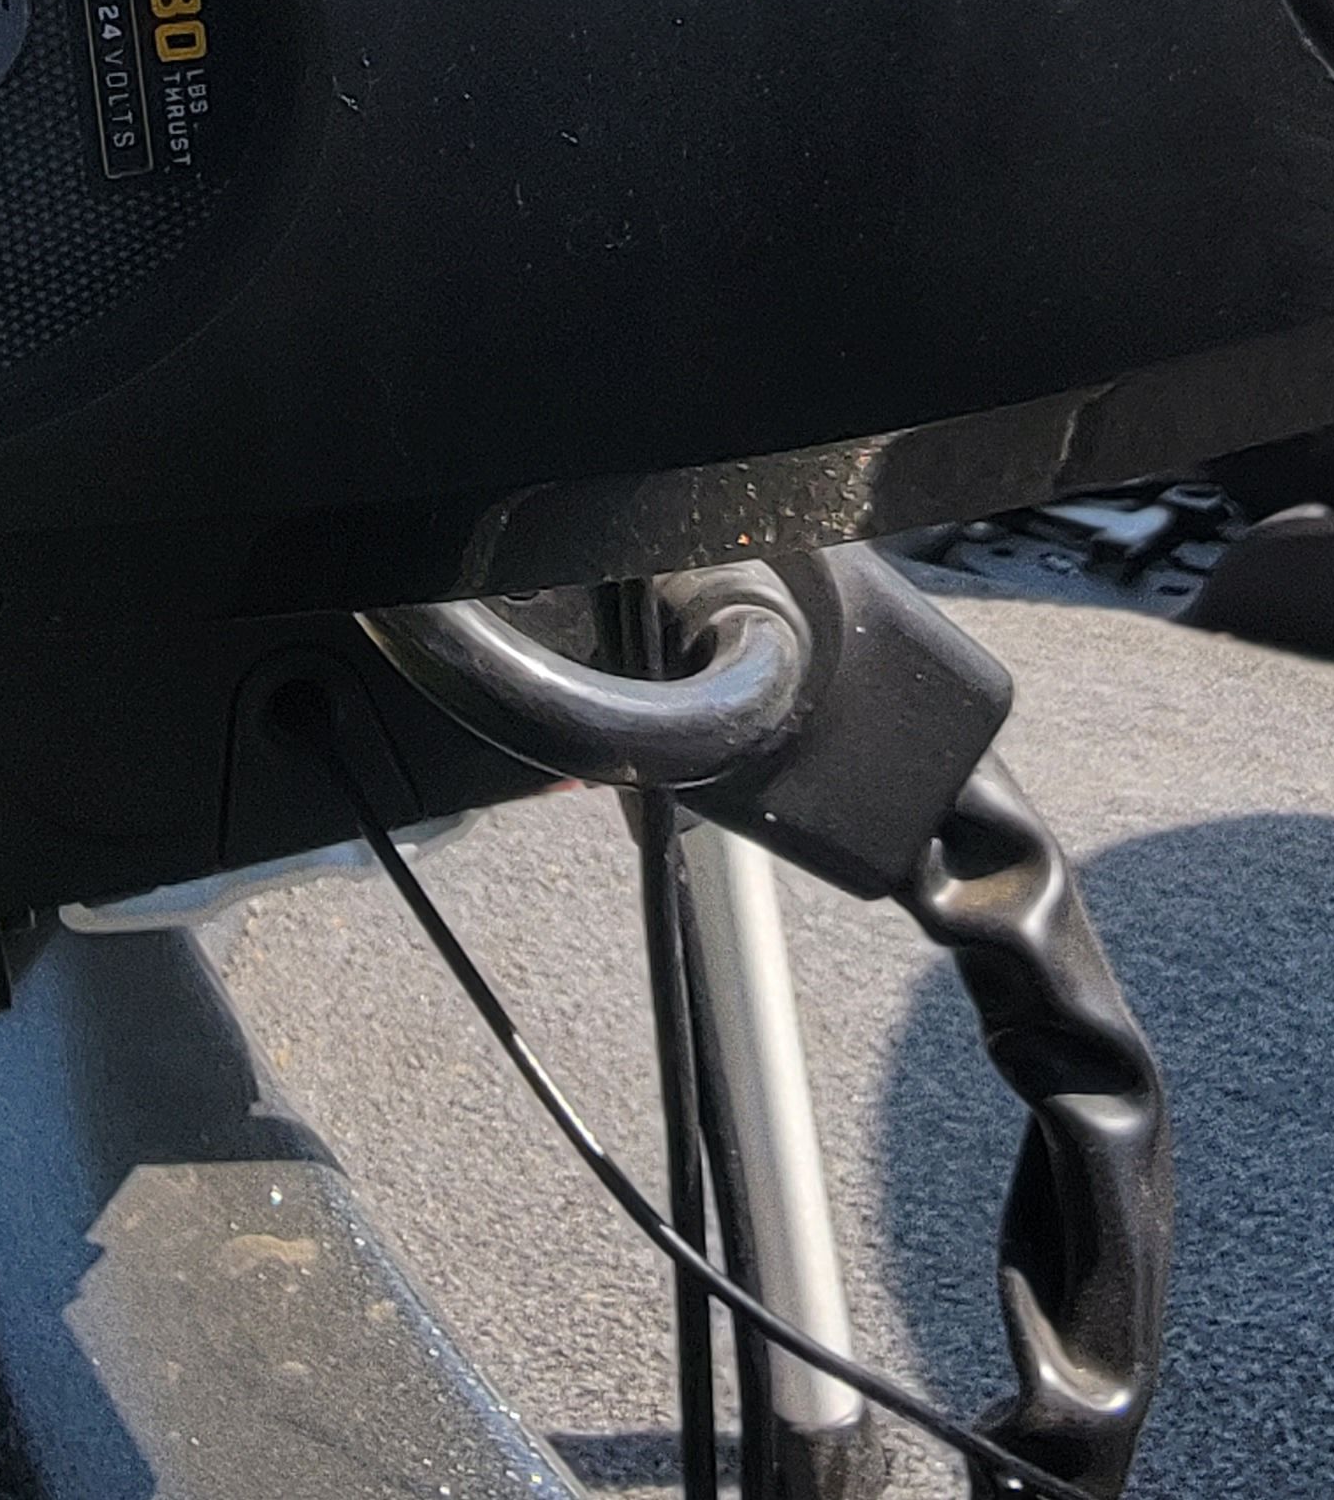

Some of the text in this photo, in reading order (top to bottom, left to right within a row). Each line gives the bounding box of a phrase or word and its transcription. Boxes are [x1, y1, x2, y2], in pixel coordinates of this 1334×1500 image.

[97, 4, 136, 149] 24 VOLTS
[163, 72, 192, 167] THRUST
